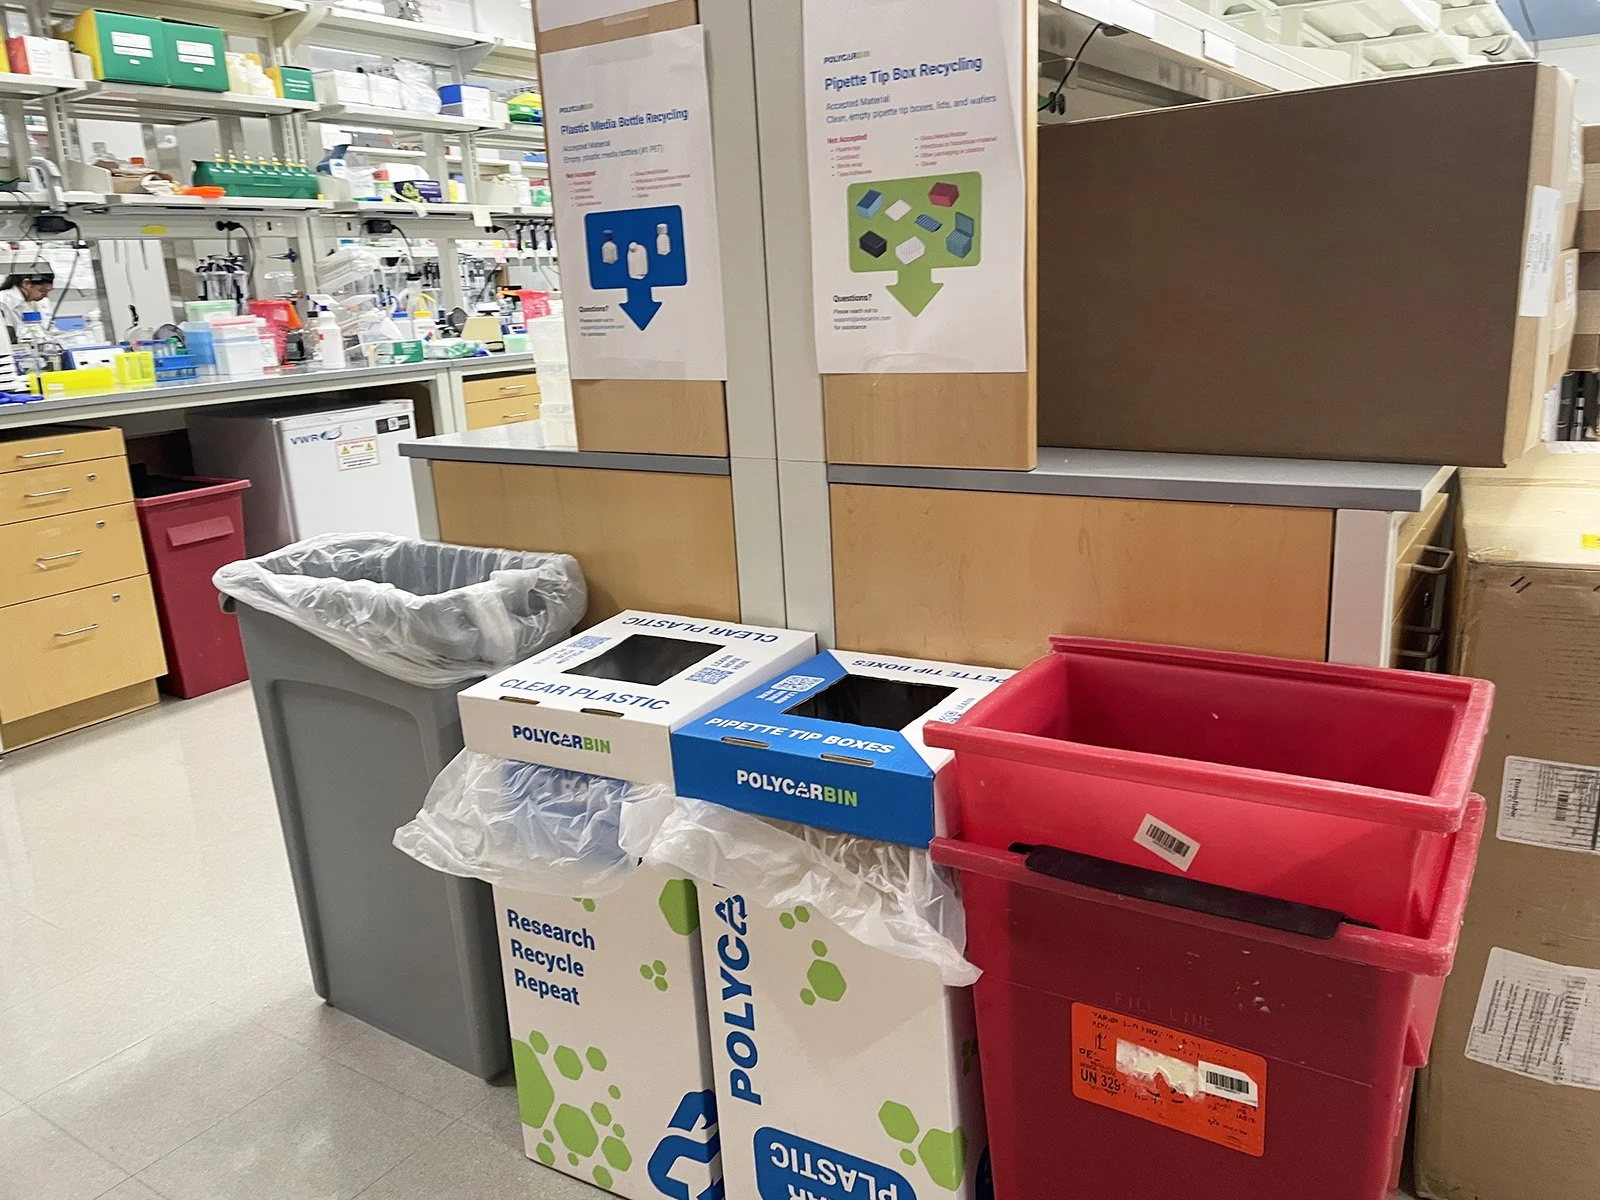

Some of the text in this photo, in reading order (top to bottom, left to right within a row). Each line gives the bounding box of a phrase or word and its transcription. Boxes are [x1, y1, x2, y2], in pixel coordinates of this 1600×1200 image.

[825, 57, 983, 92] Pipette Tip Box Recycling
[825, 95, 890, 110] Accepted Material
[873, 108, 898, 118] pipette
[953, 98, 968, 107] and
[560, 108, 688, 135] Plastic Media Bottle Recycling
[839, 133, 867, 143] Accepted
[578, 305, 609, 313] Questions?
[833, 293, 872, 302] Questions?
[290, 433, 320, 445] VWR
[622, 617, 779, 643] CLEAR PLASTIC
[852, 660, 1008, 684] PETTE TIP BOXES
[499, 678, 670, 710] CLEAR PLASTIC
[512, 725, 611, 754] POLYCARBIN
[704, 717, 895, 754] PIPETTE TIP BOXES
[736, 769, 858, 807] POLYCARBIN
[507, 908, 595, 950] Research
[510, 938, 584, 977] Recycle
[514, 967, 580, 1006] Repeat
[713, 884, 762, 1106] POLYCA
[1080, 1068, 1098, 1085] UN
[769, 1141, 898, 1200] PLASTIC
